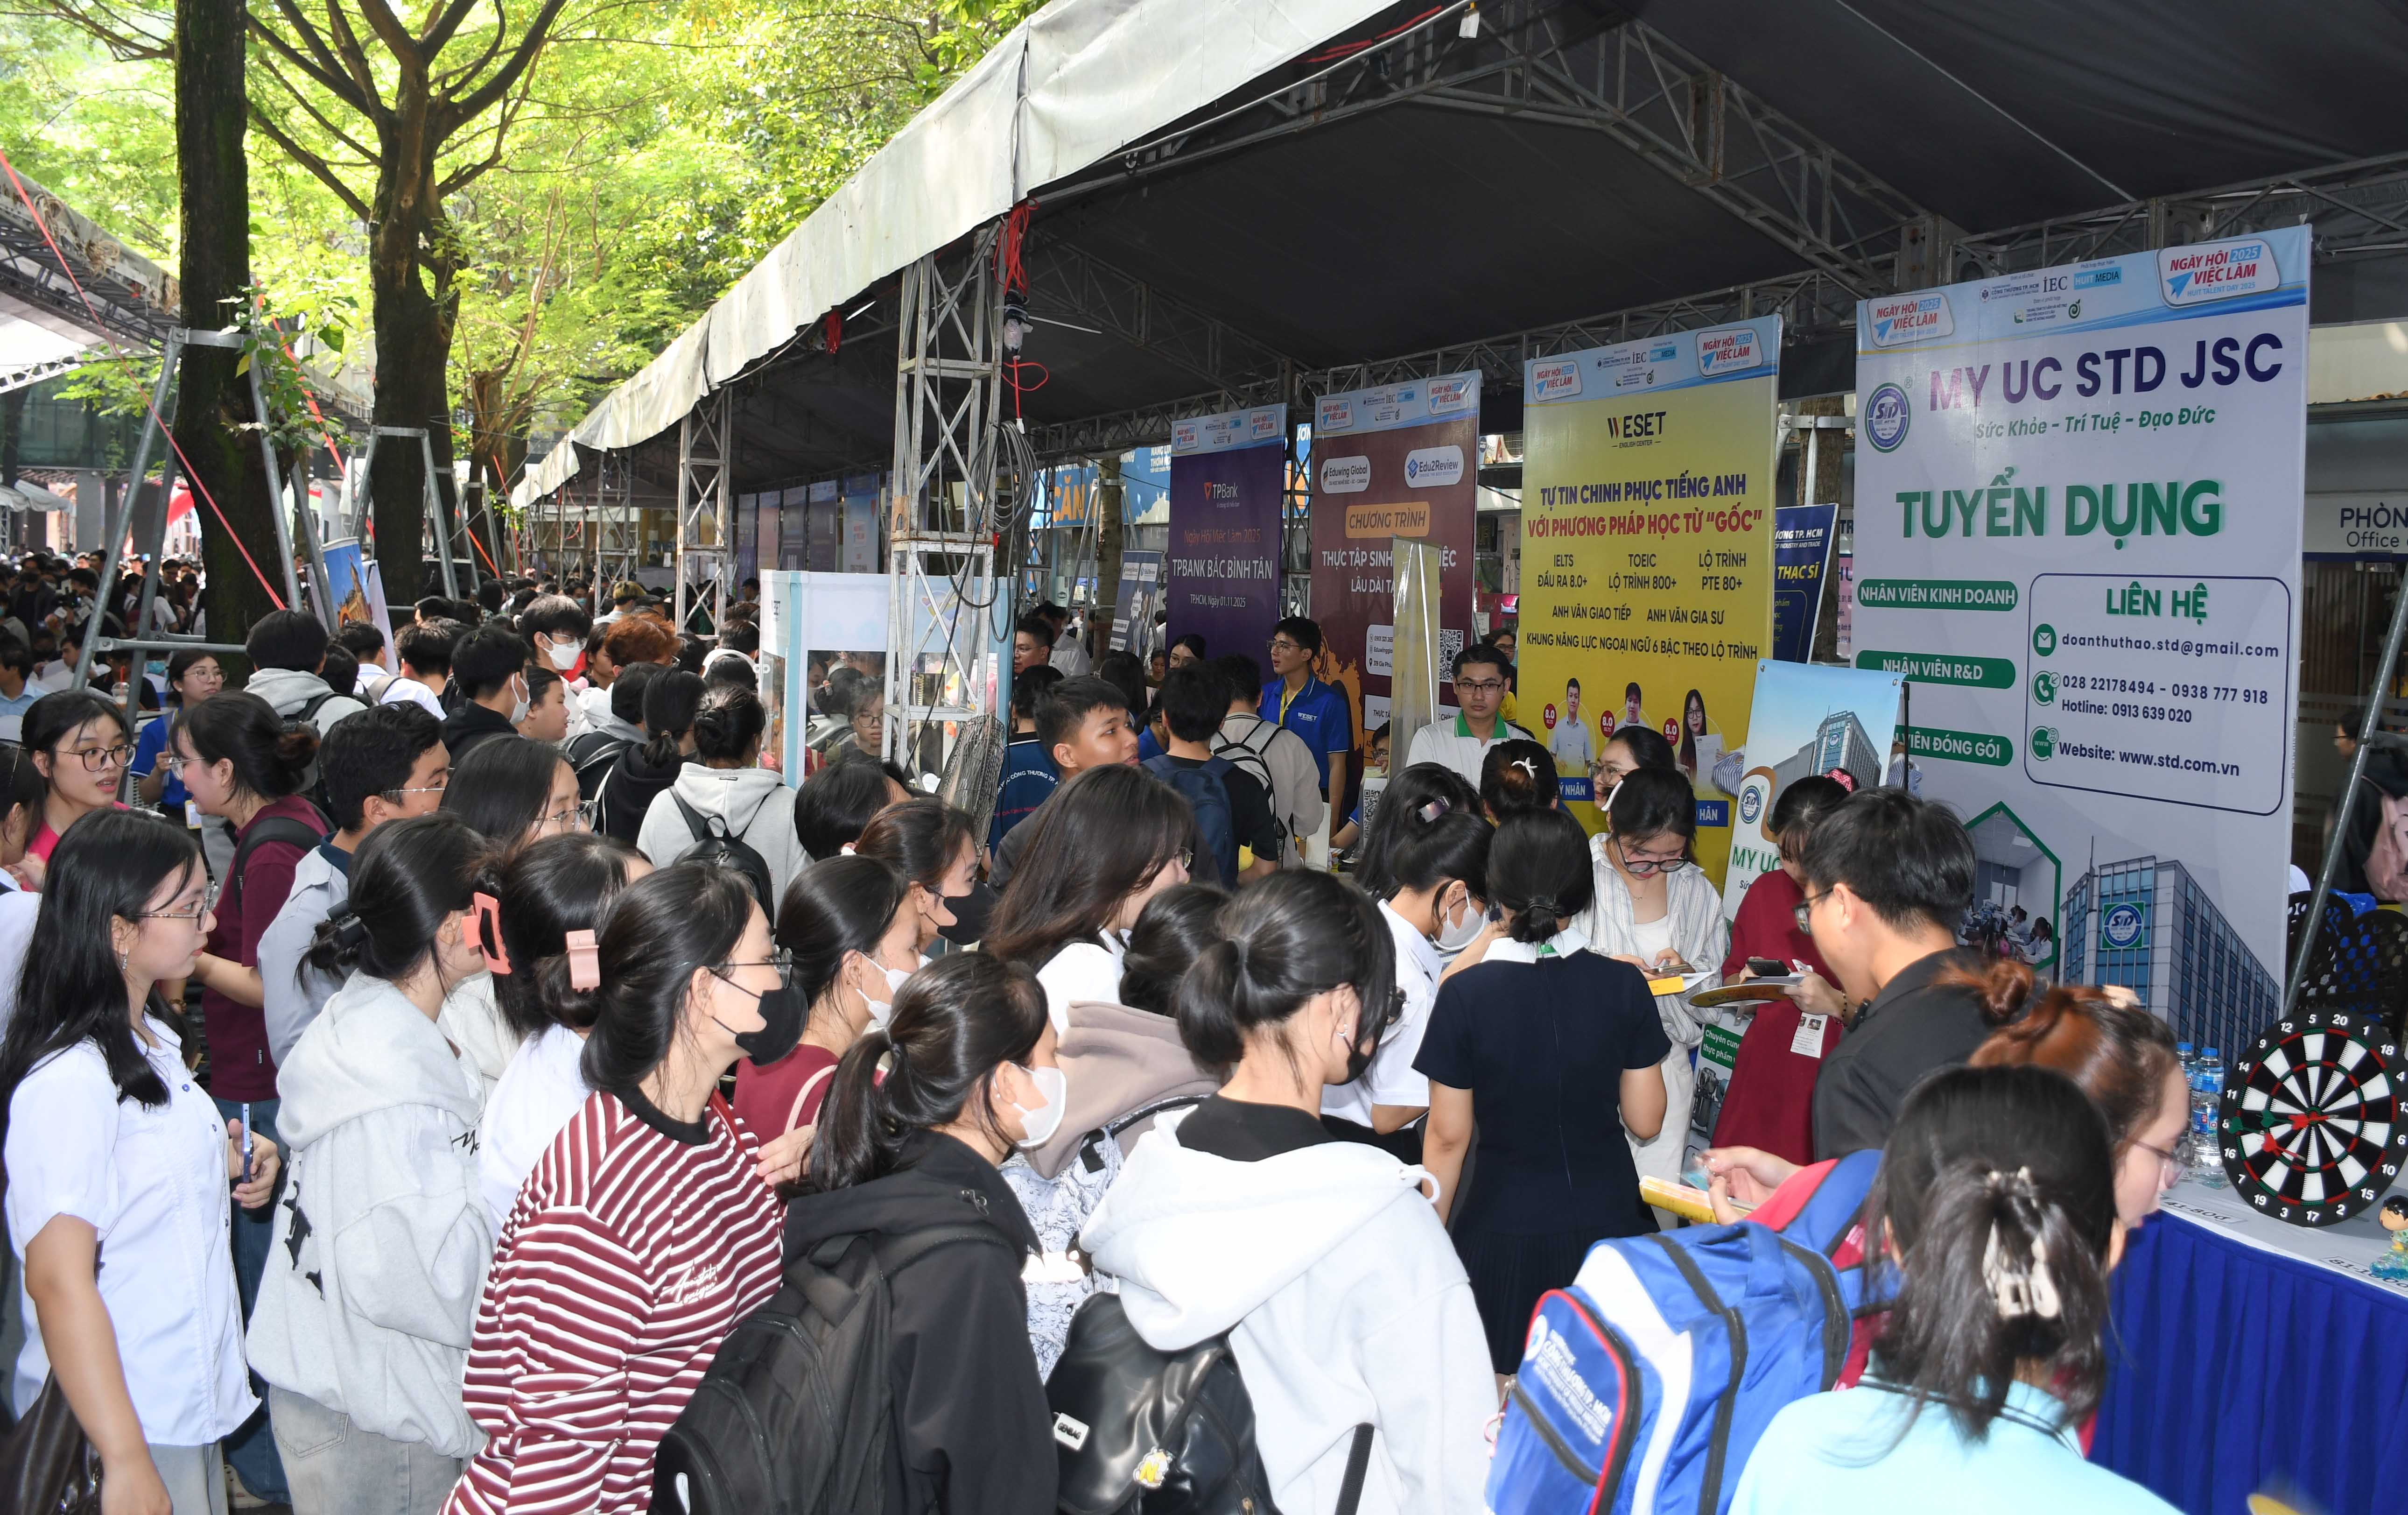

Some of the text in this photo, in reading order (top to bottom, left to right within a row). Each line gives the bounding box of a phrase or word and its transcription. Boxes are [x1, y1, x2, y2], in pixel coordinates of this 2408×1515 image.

[2170, 247, 2258, 271] NGÀY HỘI 2025
[2095, 271, 2120, 283] MEDIA
[2194, 263, 2256, 287] VIỆC LÀM
[2203, 286, 2225, 295] TALENT
[1876, 304, 1900, 318] NGÀY
[1919, 299, 1939, 310] 2025
[1894, 312, 1937, 331] VIỆC LÀM
[1703, 338, 1721, 351] NGÀY
[1930, 333, 2283, 411] MY UC STD JSC
[1608, 411, 1666, 439] WESET
[1976, 405, 2216, 439] Sức Khỏe Trí Tuệ Đạo Đức
[1329, 464, 1368, 478] Eduwing Global
[1419, 459, 1459, 472] Edu2Review
[1213, 482, 1238, 499] TPBank
[1541, 470, 1746, 511] TỰ TIN CHINH PHỤC TIẾNG ANH
[1349, 508, 1426, 529] CHƯƠNG TRÌNH
[1896, 467, 2221, 550] TUYỂN DỤNG
[2340, 502, 2408, 528] PHÒN
[1527, 514, 1549, 537] VỚI
[1552, 515, 1606, 537] PHƯƠNG
[1609, 510, 1645, 536] PHÁP
[1648, 514, 1680, 540] HỌC
[1684, 507, 1704, 533] TỪ
[1795, 528, 1823, 539] TP. HCM
[1184, 529, 1200, 546] Ngày
[1201, 528, 1212, 543] Hội
[1228, 528, 1241, 542] Làm
[1243, 528, 1261, 543] 2025
[2346, 531, 2399, 547] Office
[1172, 554, 1272, 579] TPBANK BẮC BÌNH TÂN
[1322, 547, 1393, 571] THỰC TẬP SINH
[1554, 550, 1746, 571] IELTS TOEIC LỘ TRÌNH
[1557, 572, 1742, 592] RA 8.0+ LỘ TRÌNH 800+ PTE 80+
[1777, 565, 1807, 584] THẠC
[1809, 562, 1820, 579] SĨ
[1351, 575, 1384, 593] LÂU DÀI
[1860, 583, 2015, 605] NHÂN VIÊN KINH DOANH
[1208, 595, 1220, 608] Ngày
[1220, 596, 1246, 607] 01.11.2025
[2106, 581, 2207, 626] LIÊN HỆ
[1552, 603, 1724, 625] ANH VĂN GIAO TIẾP ANH VĂN GIA SƯ
[1526, 632, 1758, 661] KHUNG NĂNG LỰC NGOẠI NGỮ 6 BẬC THEO LỘ TRÌNH
[2061, 634, 2279, 657] doanthuthao.std@gmail.com
[1882, 658, 1983, 680] NHÂN VIÊN R&D
[2063, 675, 2268, 705] 028 22178494 0938 777 918
[1545, 709, 1554, 719] 8.0
[2062, 699, 2191, 723] Hotline: 0913 639 020
[1602, 717, 1612, 727] 8.0
[1665, 725, 1677, 735] 8.0
[1933, 734, 2000, 759] ĐÓNG GÓI
[2059, 742, 2240, 777] Website: www.std.com.vn
[1011, 771, 1026, 780] CÔNG
[1027, 770, 1048, 779] THƯƠNG
[1566, 782, 1586, 796] NHÂN
[1699, 806, 1718, 821] HÂN
[1732, 845, 1758, 871] MY
[2281, 1022, 2293, 1032] 12
[2332, 1014, 2348, 1026] 20
[1705, 1029, 1726, 1045] Chuyên
[1703, 1043, 1733, 1063] thực phẩm
[2380, 1044, 2394, 1055] 18
[2227, 1089, 2237, 1099] 11
[2222, 1119, 2229, 1129] 8
[2381, 1164, 2395, 1176] 10
[1057, 1422, 1082, 1440] GENBAG
[1139, 1460, 1159, 1483] N
